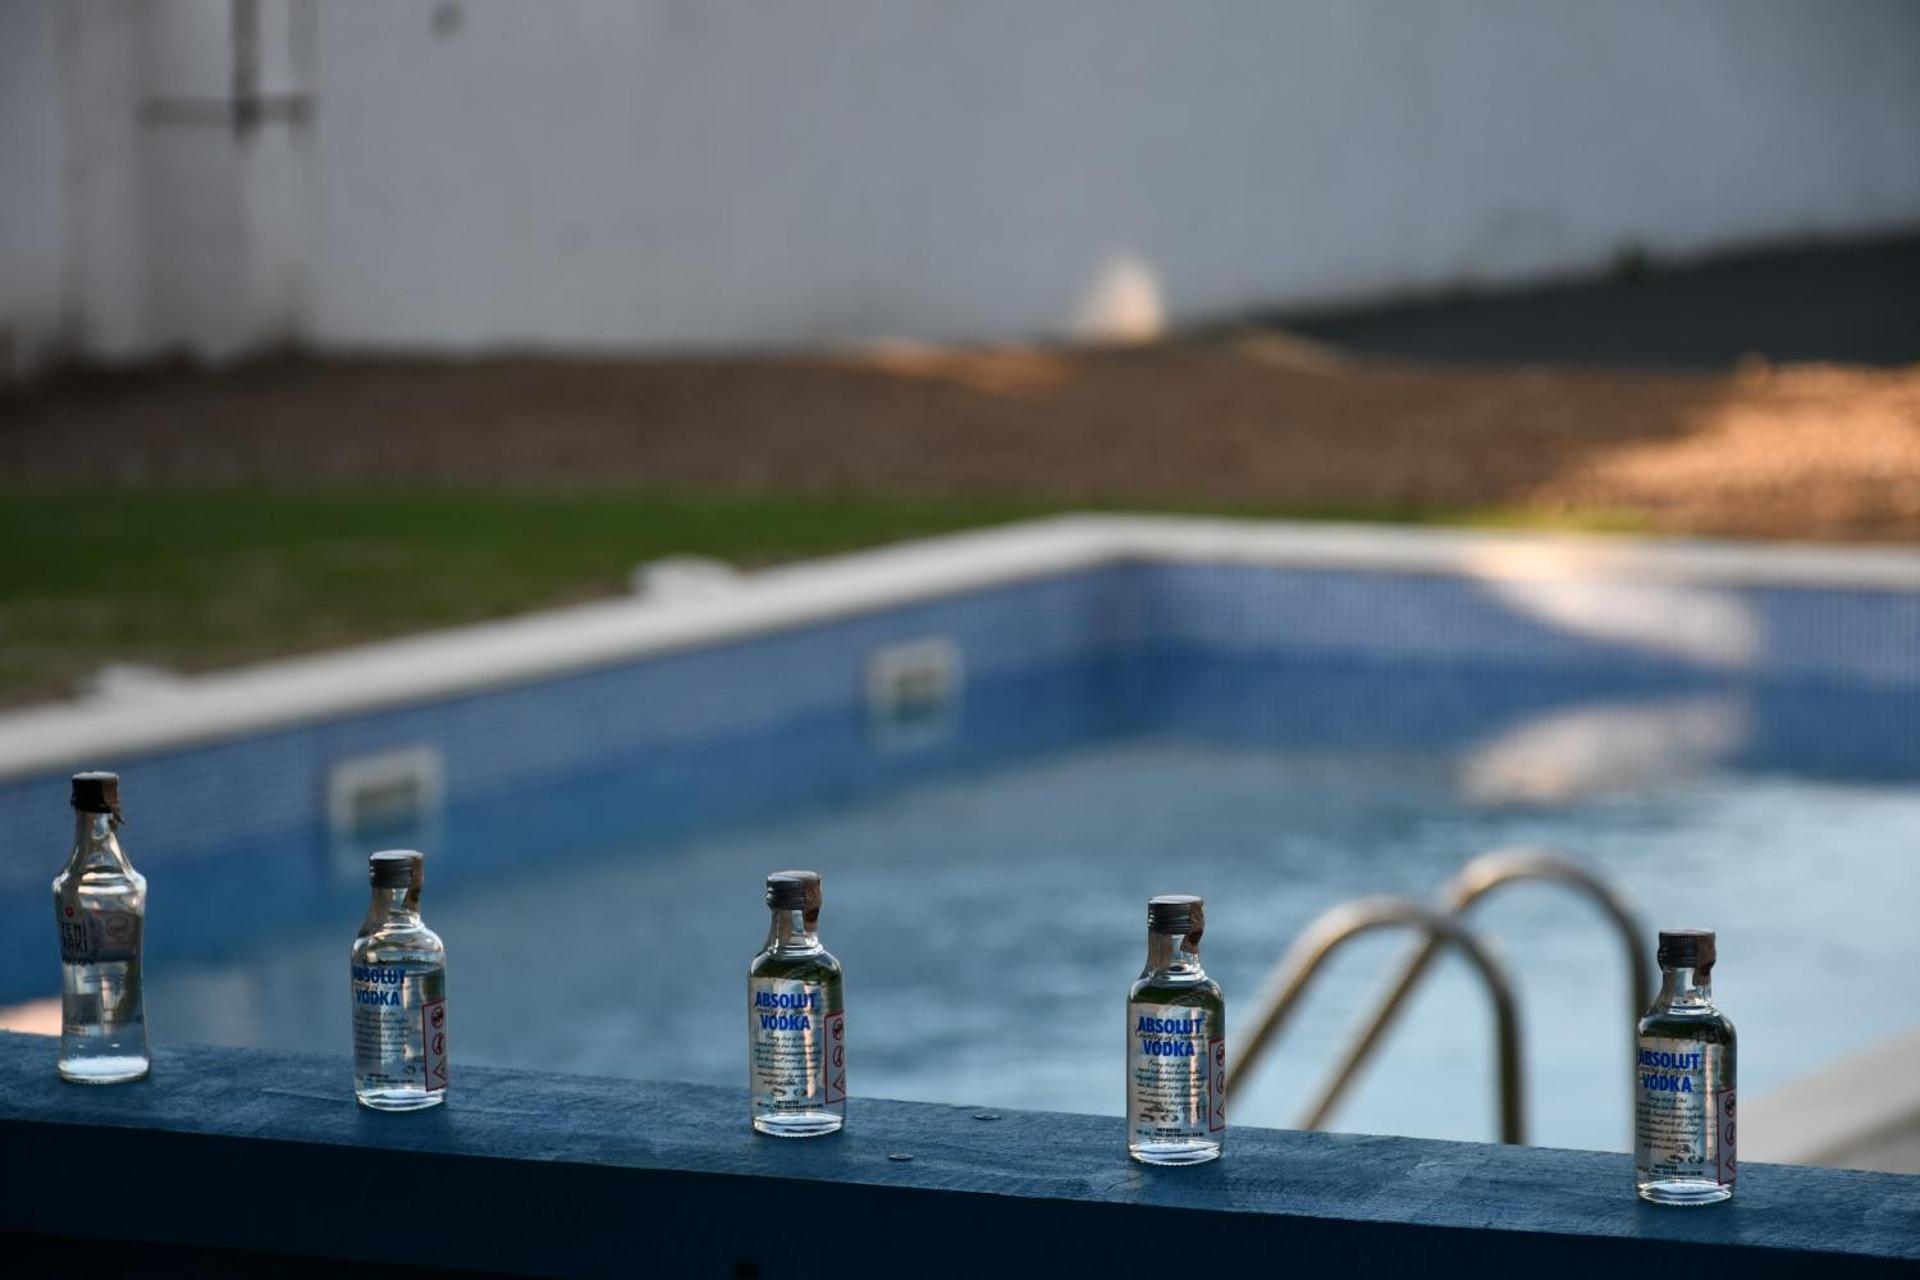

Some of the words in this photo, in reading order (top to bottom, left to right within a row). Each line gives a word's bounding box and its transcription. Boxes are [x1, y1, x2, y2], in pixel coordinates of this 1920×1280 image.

[352, 965, 406, 985] ABSOLUT
[356, 988, 400, 1006] VODKA
[755, 991, 817, 1010] ABSOLUT
[761, 1014, 811, 1030] VODKA
[1138, 1016, 1202, 1034] ABSOLUT
[1143, 1040, 1195, 1057] VODKA
[1639, 1049, 1700, 1070] ABSOLUT
[1643, 1074, 1692, 1093] VODKA
